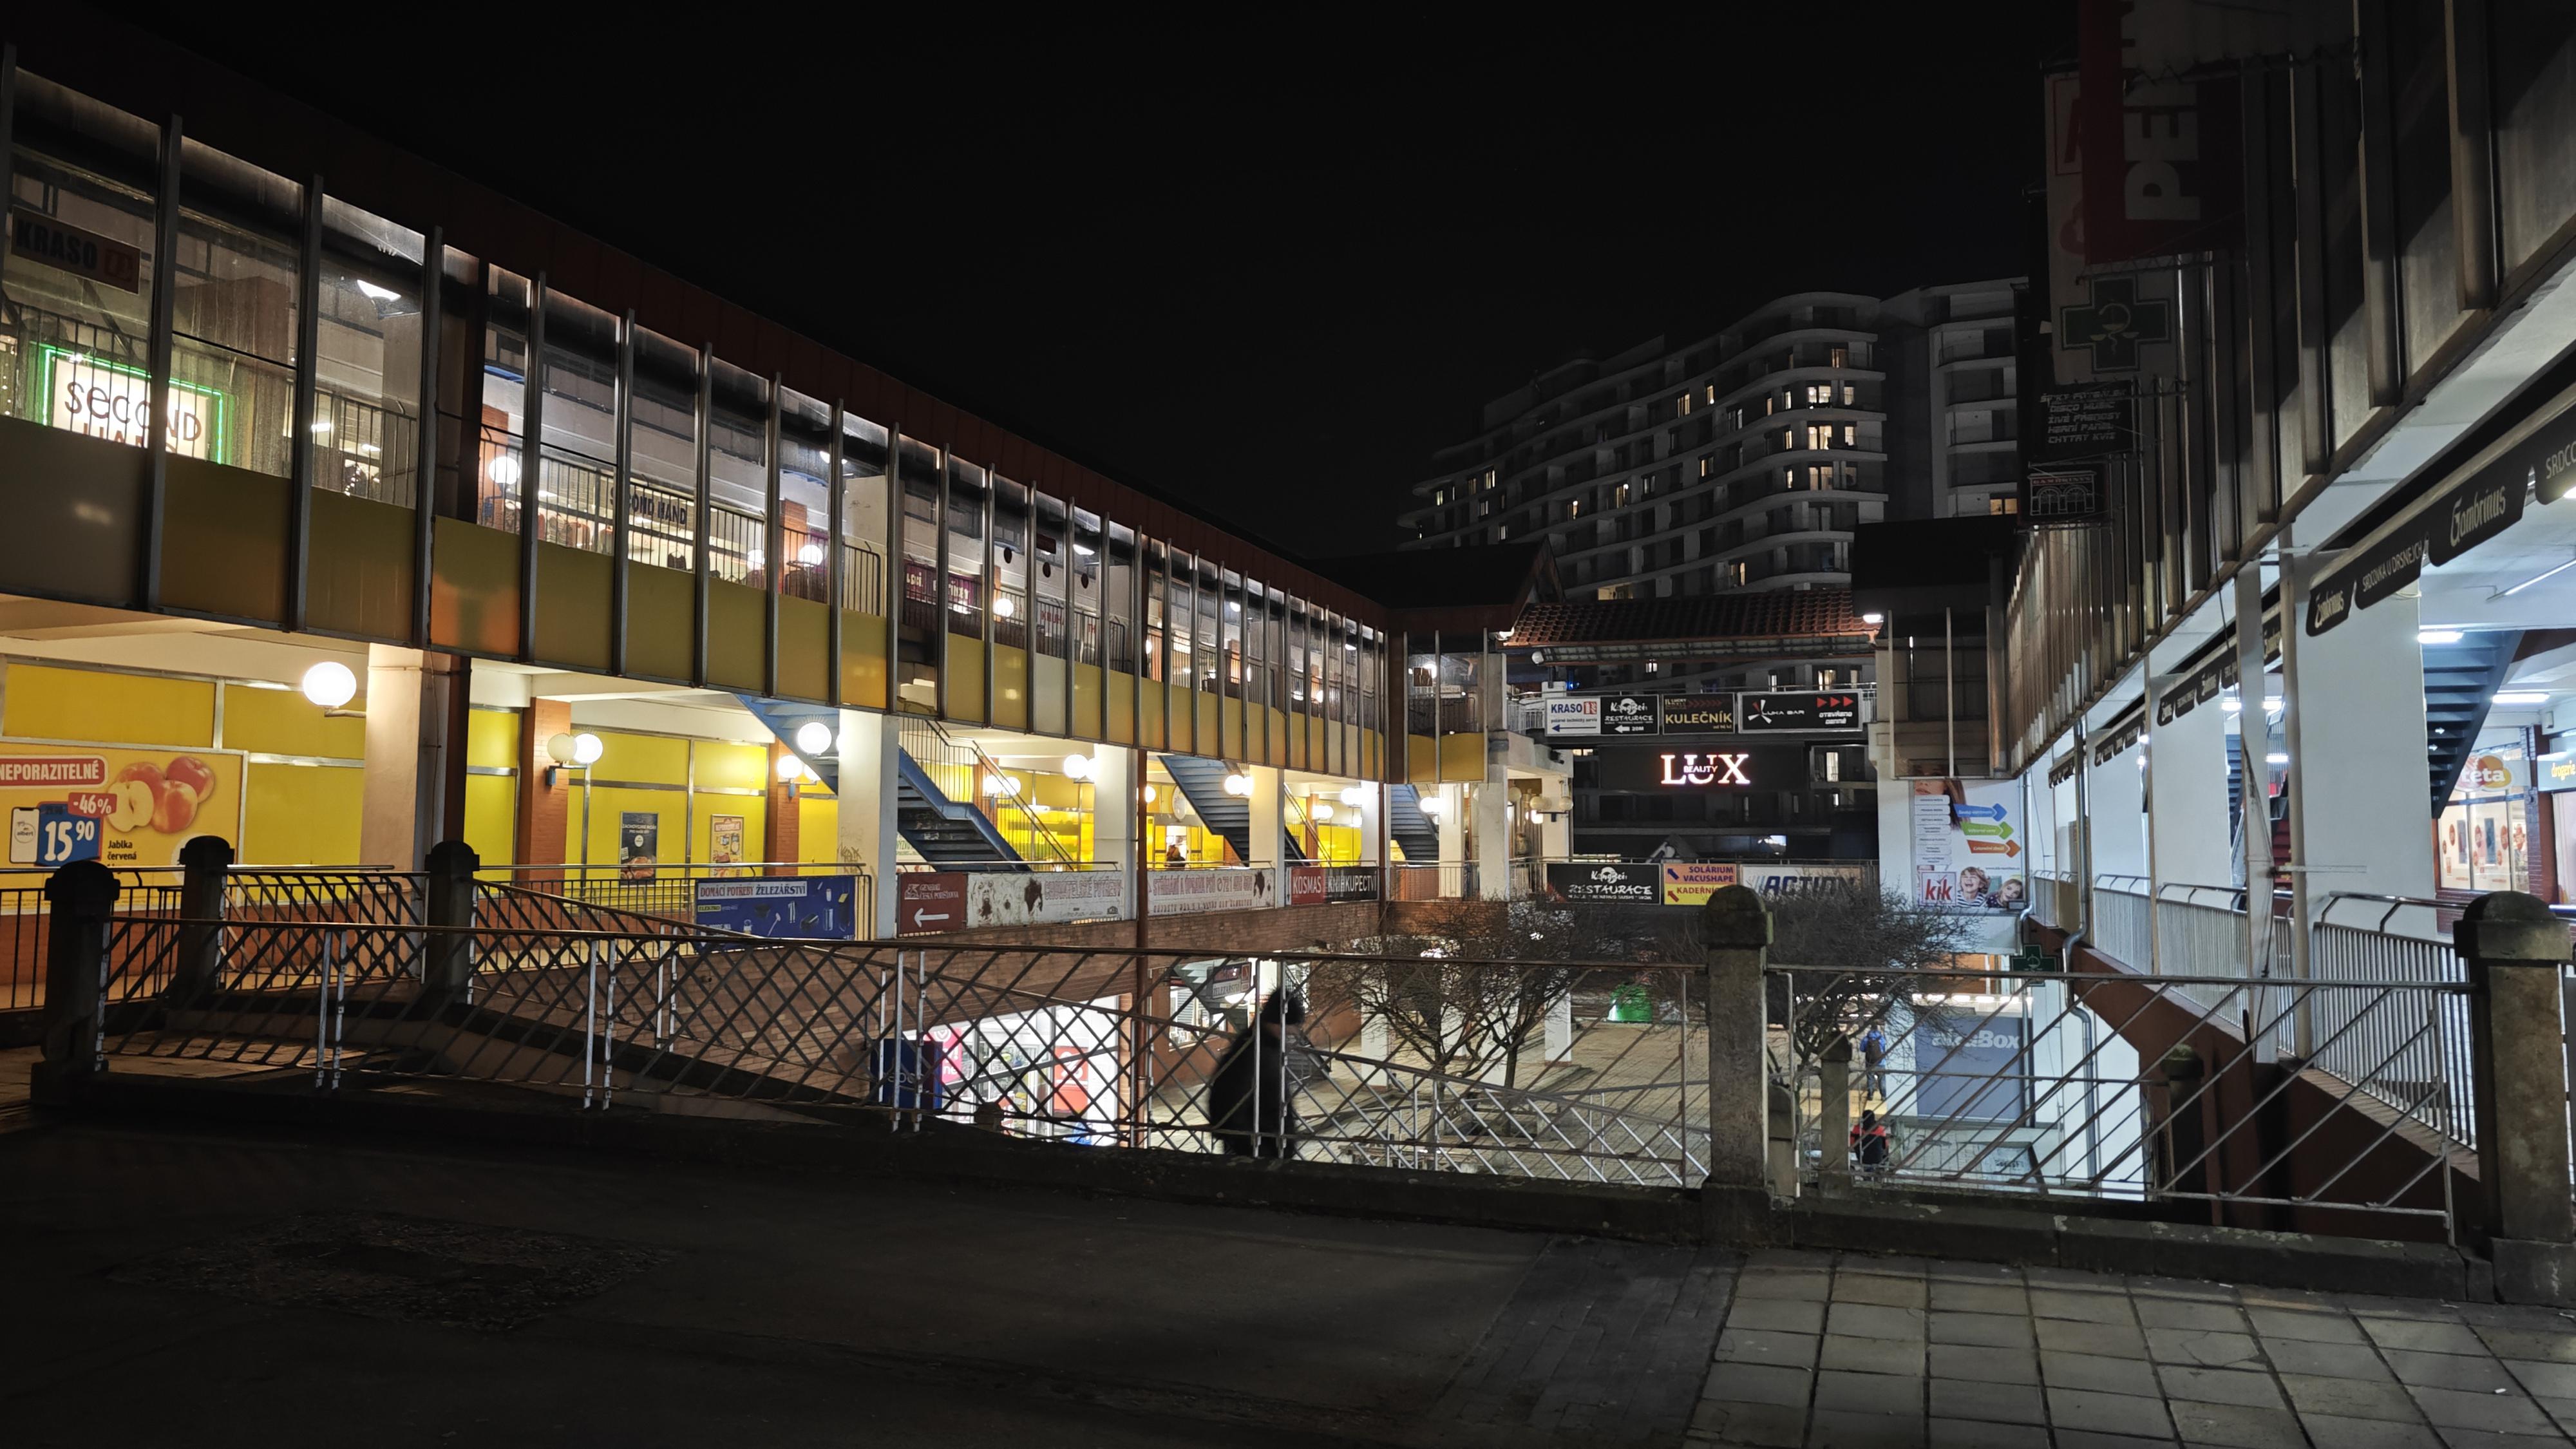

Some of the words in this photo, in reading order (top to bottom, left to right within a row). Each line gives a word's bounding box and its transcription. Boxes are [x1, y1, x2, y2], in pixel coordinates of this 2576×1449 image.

[16, 220, 97, 268] KRASO
[2050, 404, 2079, 412] DISCO
[658, 500, 687, 525] HAND
[2450, 485, 2506, 547] Gambrinus
[1551, 703, 1583, 714] KRASO
[1665, 710, 1732, 724] KULEČNÍK
[1660, 753, 1751, 784] LUX
[2461, 768, 2506, 783] teta
[73, 794, 112, 814] -46%
[108, 840, 133, 849] Jablka
[107, 851, 137, 860] červená
[1689, 865, 1734, 874] SOLÁRIUM
[1293, 876, 1321, 894] KOSMAS
[1328, 871, 1377, 893] KNIHKUPECTVÍ
[1568, 884, 1653, 895] RESTAURACE
[1925, 878, 1951, 900] kik
[701, 885, 725, 897] DOMÁCÍ
[727, 884, 753, 896] POTŘEBY
[755, 883, 806, 895] ŽELEZÁŘSTVÍ
[1677, 886, 1718, 895] KADEŘNÍ
